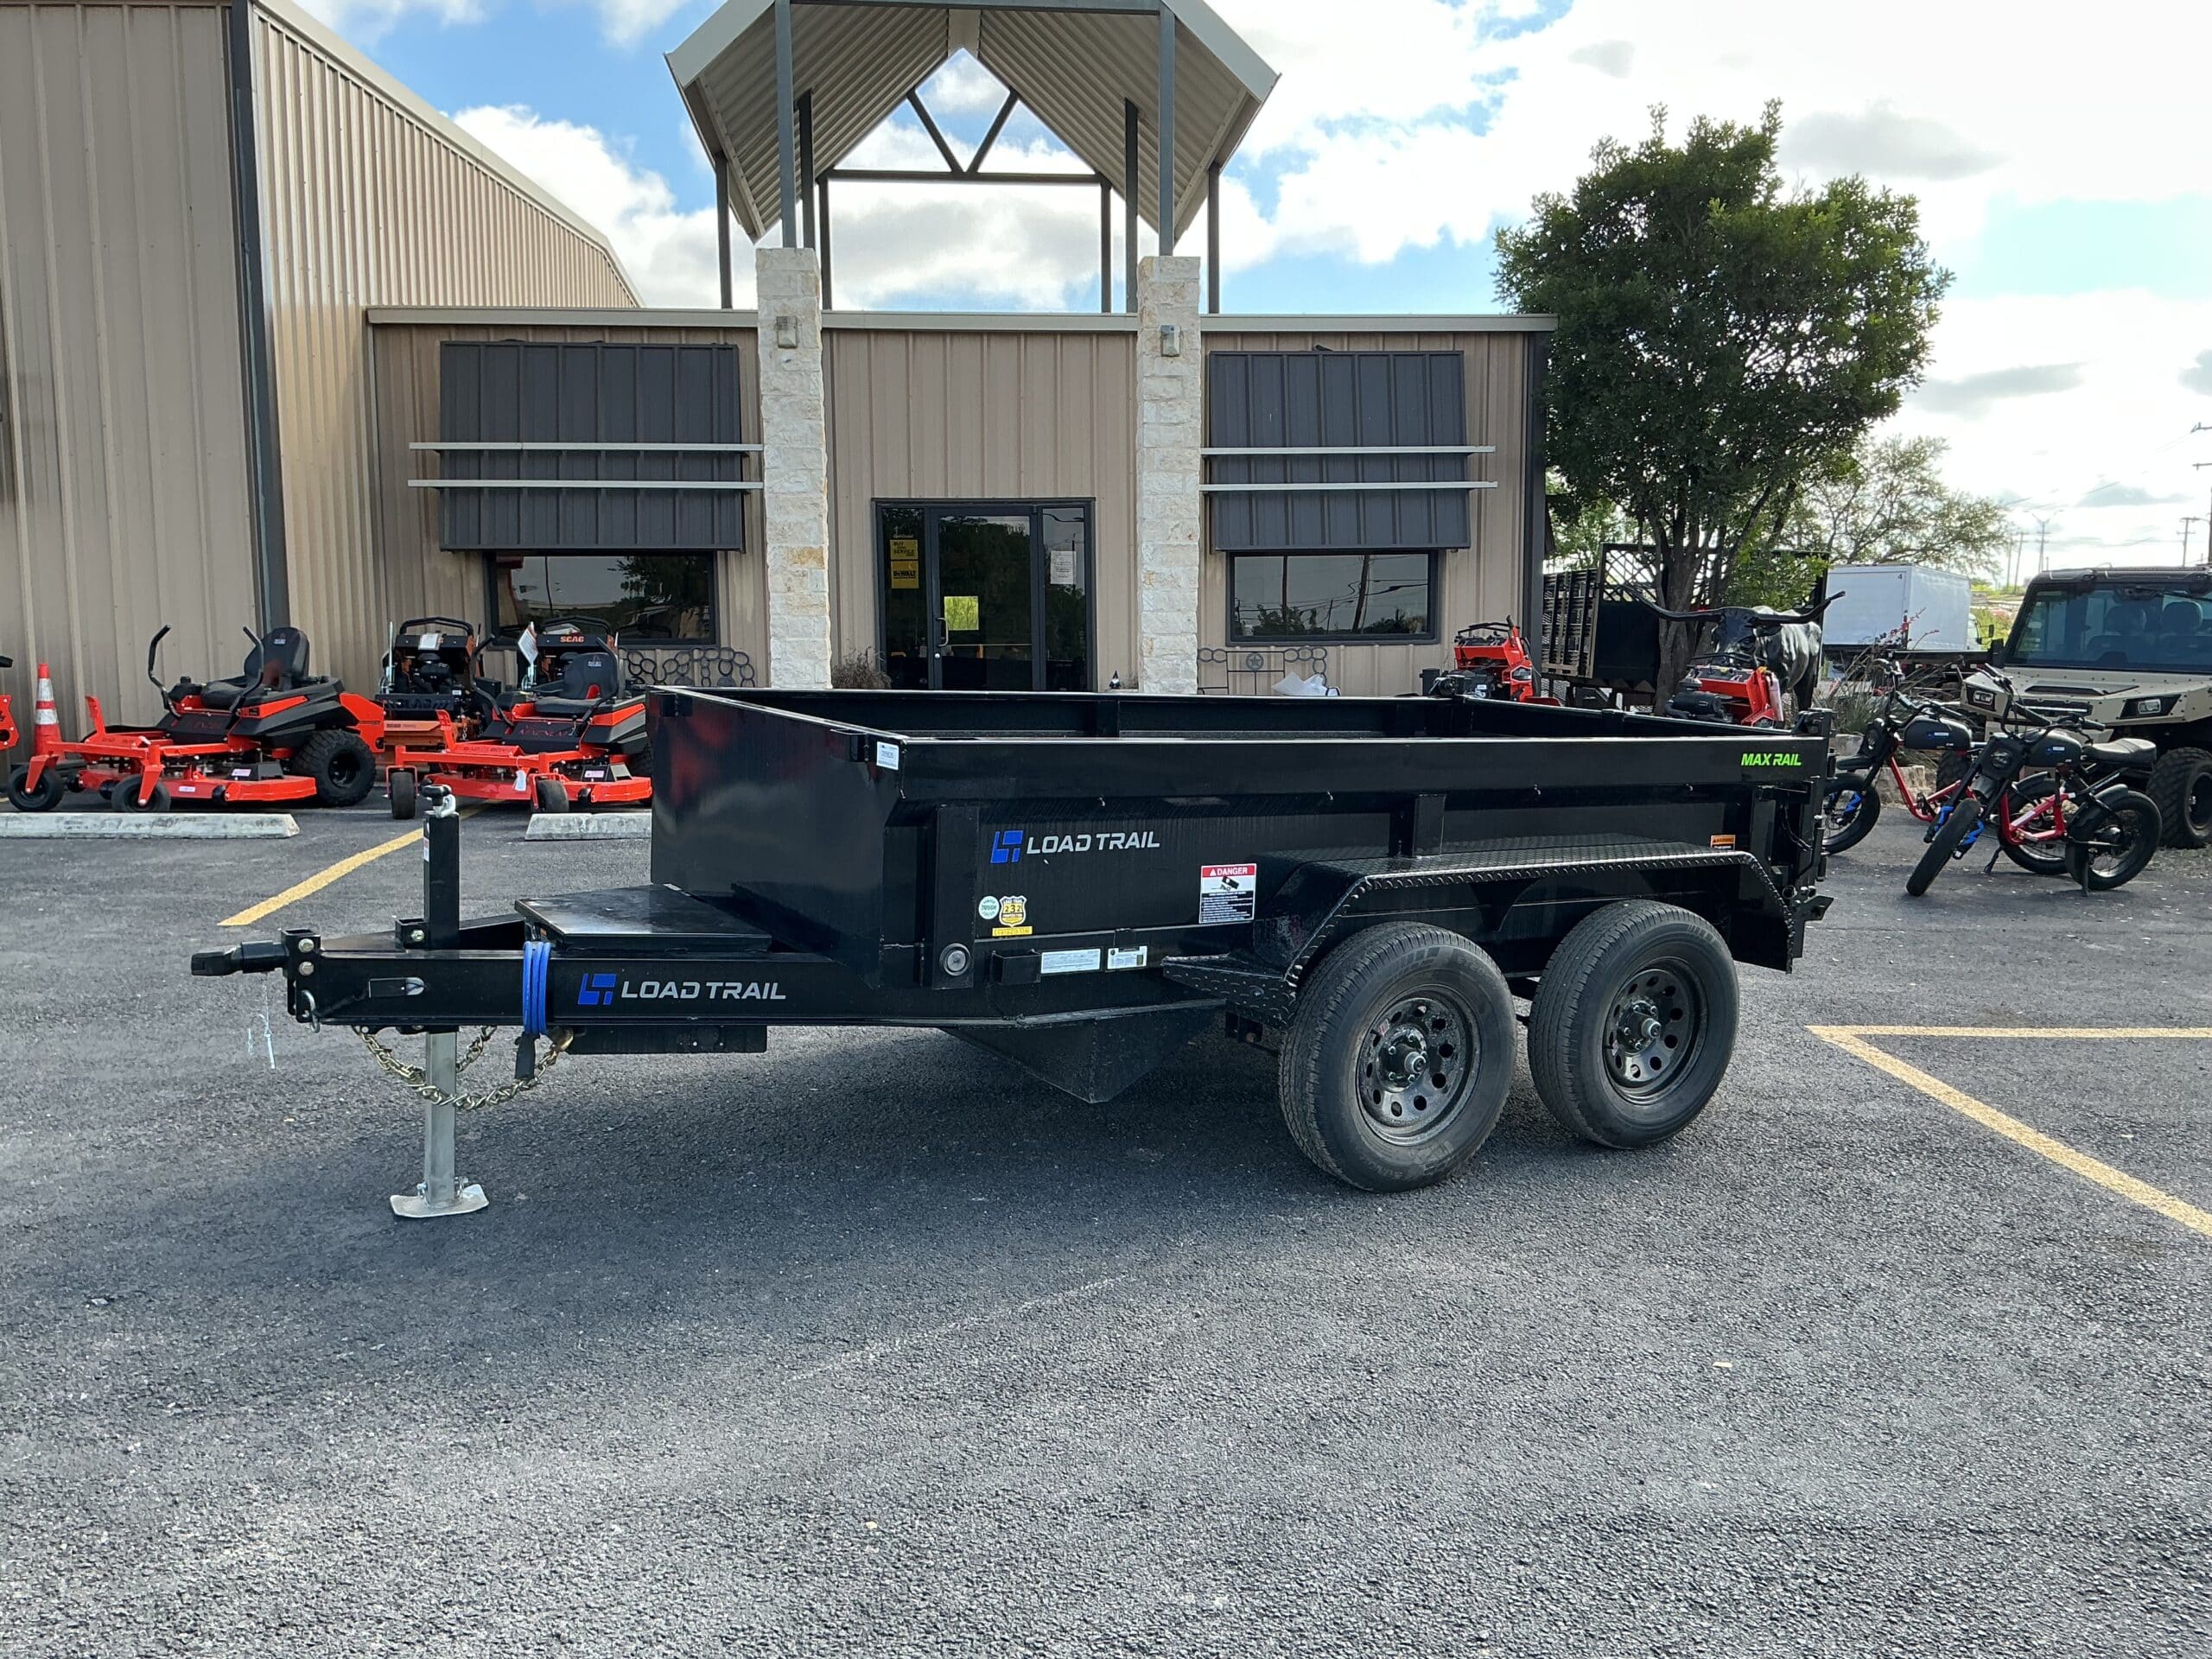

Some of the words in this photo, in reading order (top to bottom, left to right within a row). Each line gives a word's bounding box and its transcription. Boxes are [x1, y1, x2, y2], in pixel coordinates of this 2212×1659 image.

[1740, 753, 1772, 766] MAX
[1772, 753, 1802, 766] RAIL
[1027, 834, 1092, 855] LOAD
[1096, 830, 1160, 851] TRAIL
[1217, 867, 1249, 876] DANGER
[1004, 904, 1021, 913] 232
[621, 981, 701, 999] LOAD
[706, 982, 786, 1000] TRAIL
